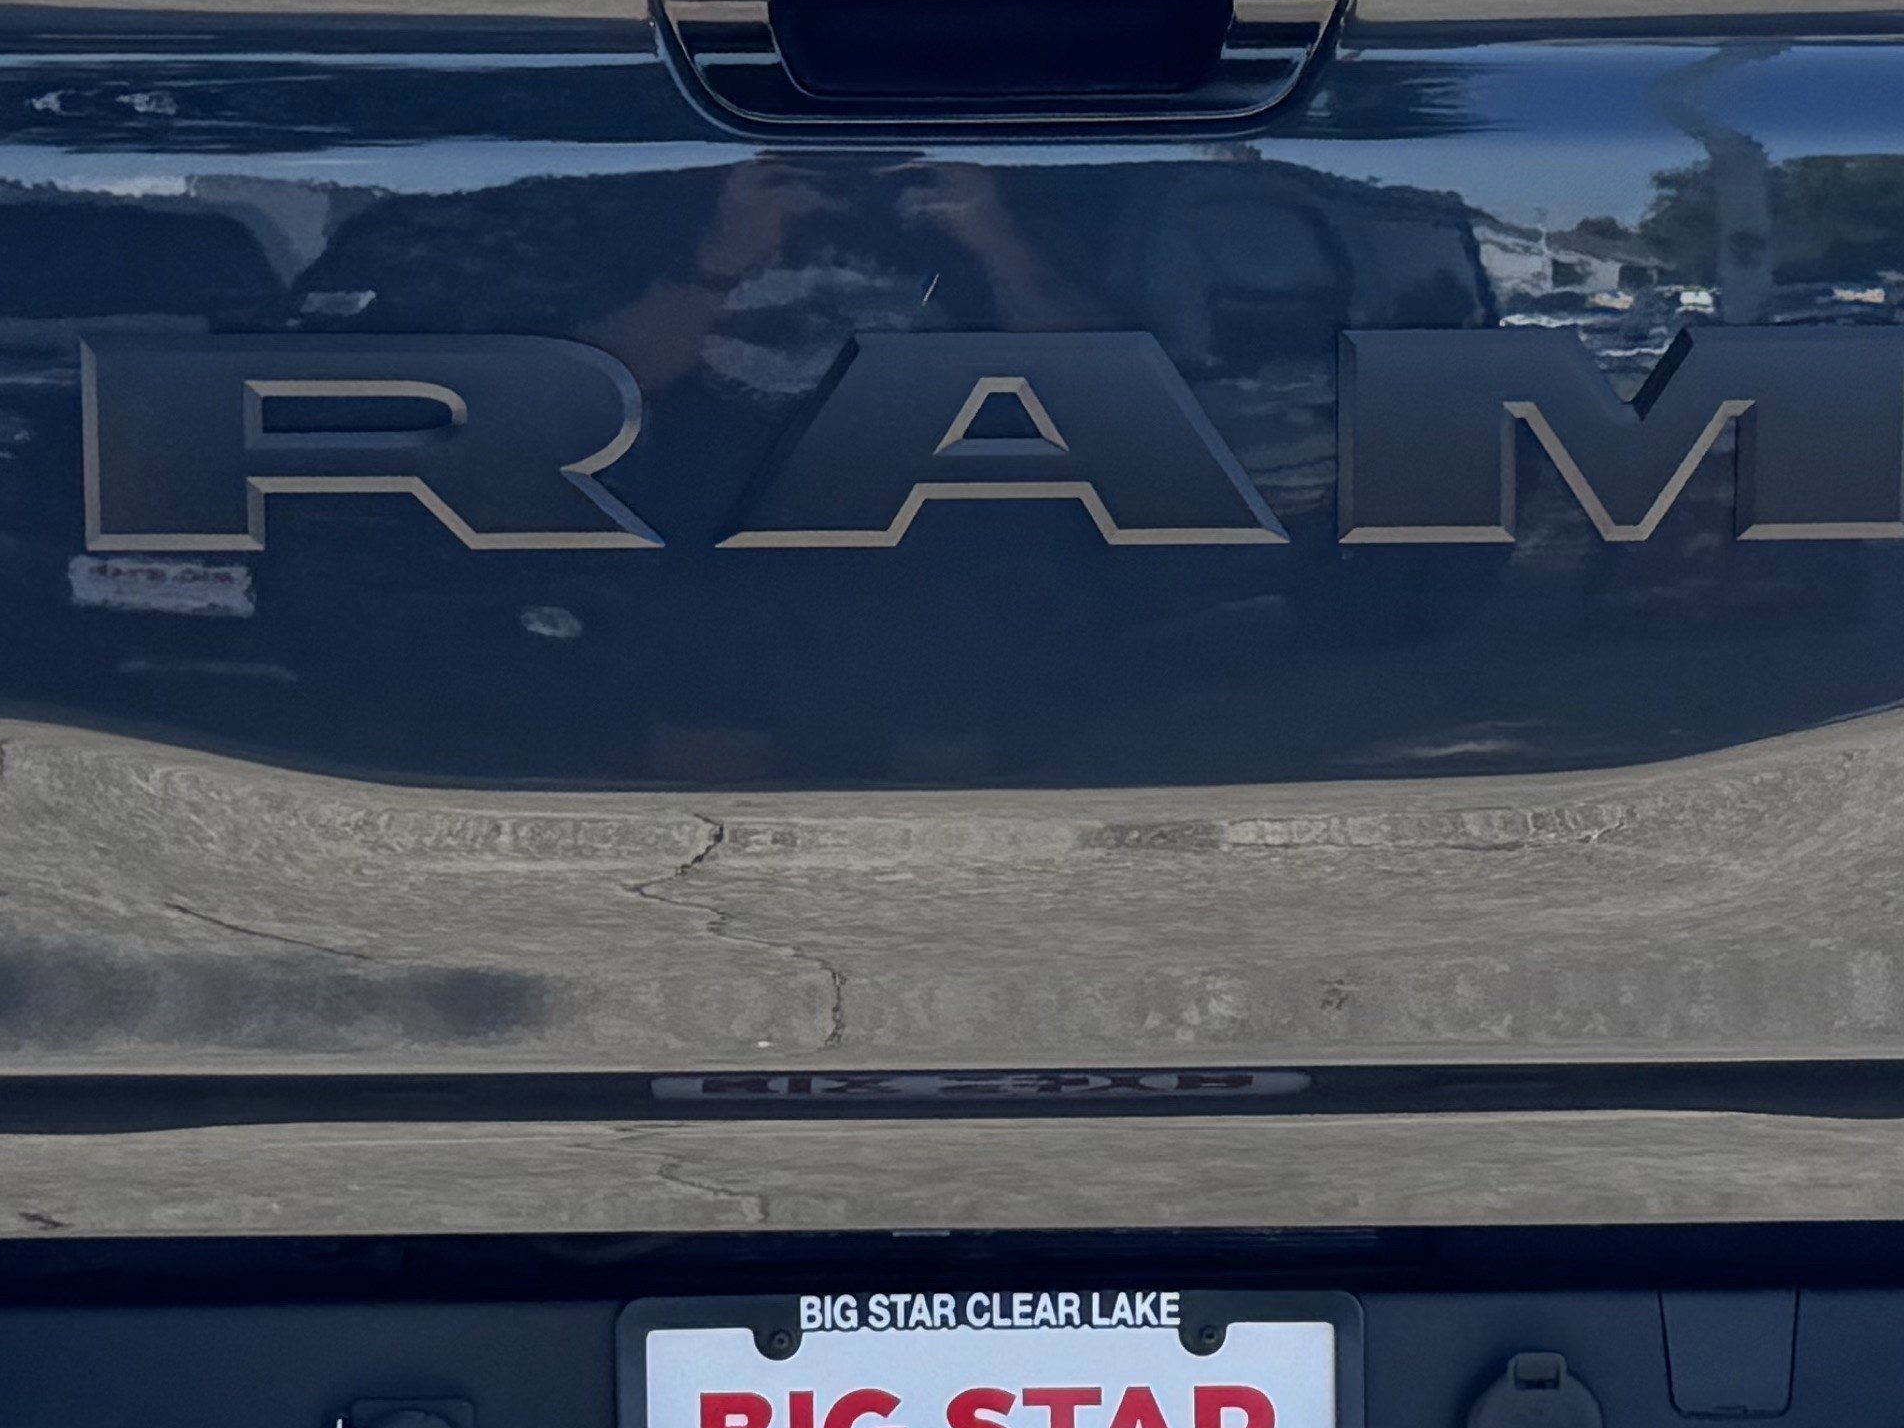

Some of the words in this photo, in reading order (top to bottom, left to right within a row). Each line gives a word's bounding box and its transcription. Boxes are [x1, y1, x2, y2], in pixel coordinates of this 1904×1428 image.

[798, 1294, 859, 1330] BIG
[867, 1292, 957, 1330] STAR
[965, 1291, 1082, 1328] CLEAR
[1091, 1290, 1182, 1328] LAKE
